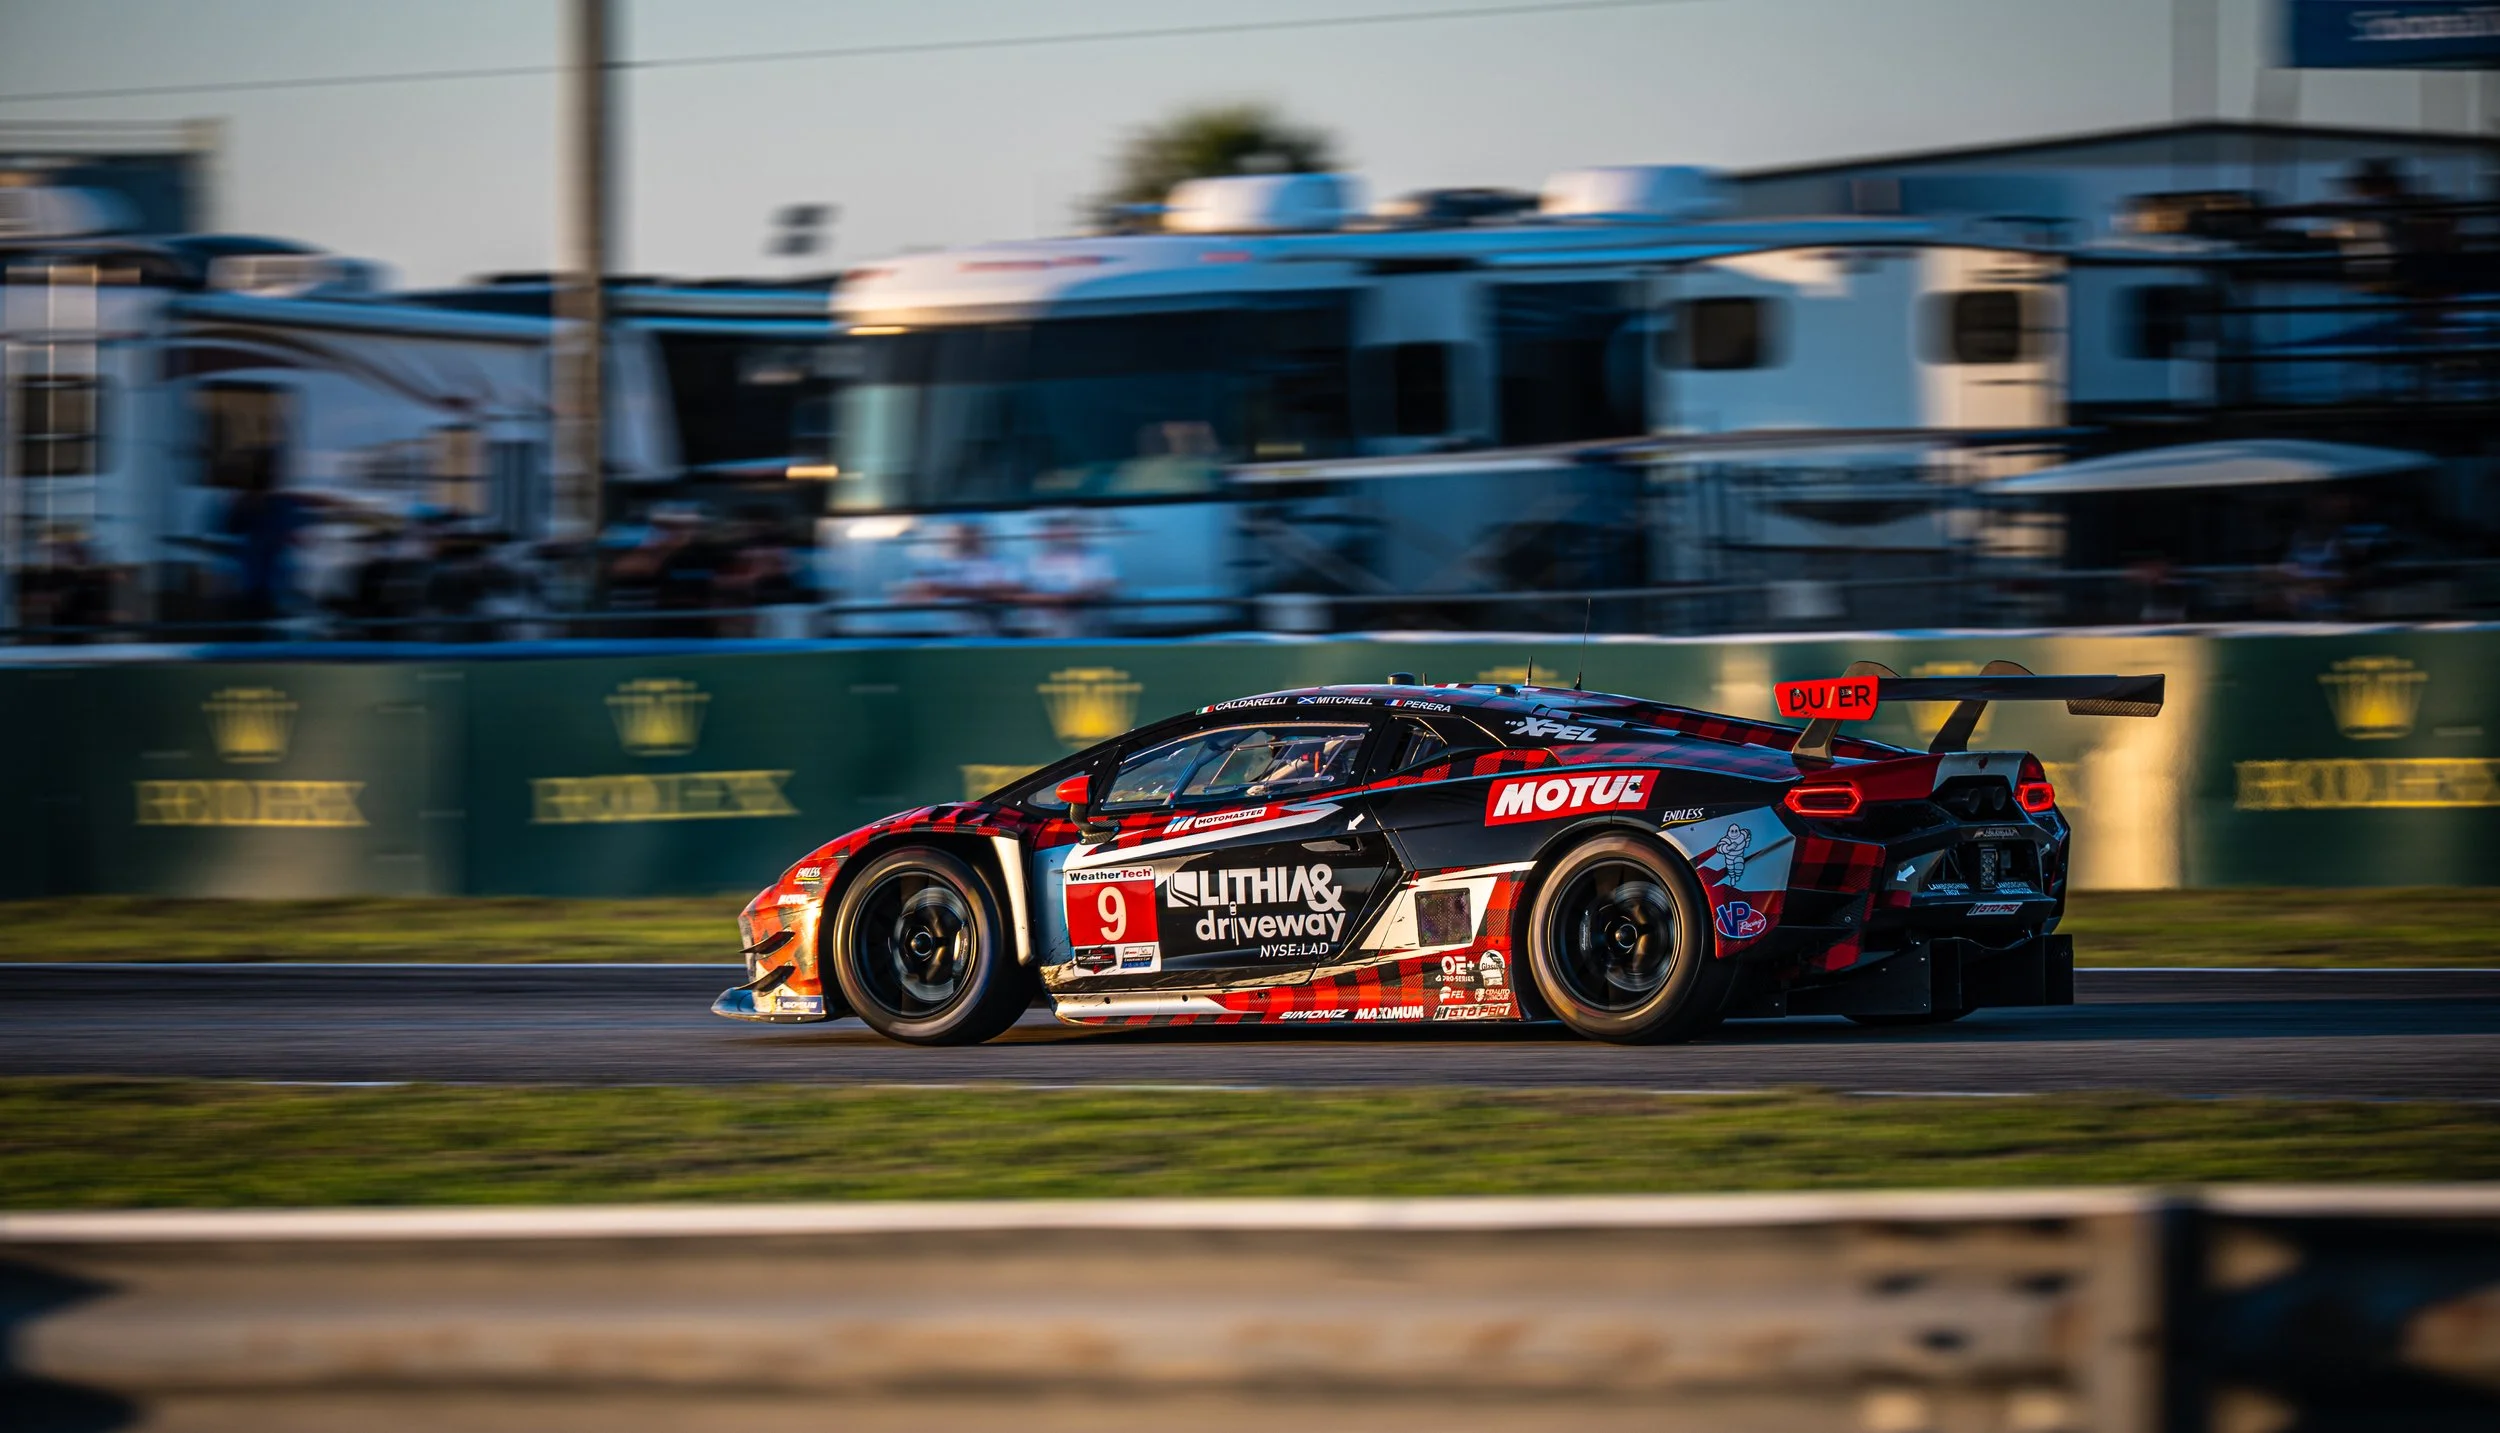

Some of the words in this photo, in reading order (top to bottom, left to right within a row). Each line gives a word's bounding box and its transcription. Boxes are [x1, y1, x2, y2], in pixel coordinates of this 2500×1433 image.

[1215, 696, 1288, 711] CALDARELLI
[1316, 696, 1373, 705] MITCHELL
[1404, 700, 1451, 713] PERERA
[1509, 716, 1600, 742] XPEL
[1492, 774, 1645, 817] MOTUL
[1197, 808, 1264, 826] MOTOMASTER
[1662, 807, 1705, 822] ENDLESS
[1097, 886, 1127, 942] 9
[1716, 901, 1751, 938] VP
[1196, 908, 1346, 946] driveway
[1259, 942, 1329, 958] NYSE:LAD
[1441, 956, 1475, 975] OE+
[1451, 990, 1465, 999] FEL
[1279, 1008, 1350, 1020] SIMONIZ
[1354, 1005, 1424, 1020] MAXIMUM
[1448, 1006, 1477, 1018] GTD
[1477, 1005, 1508, 1016] PRO
